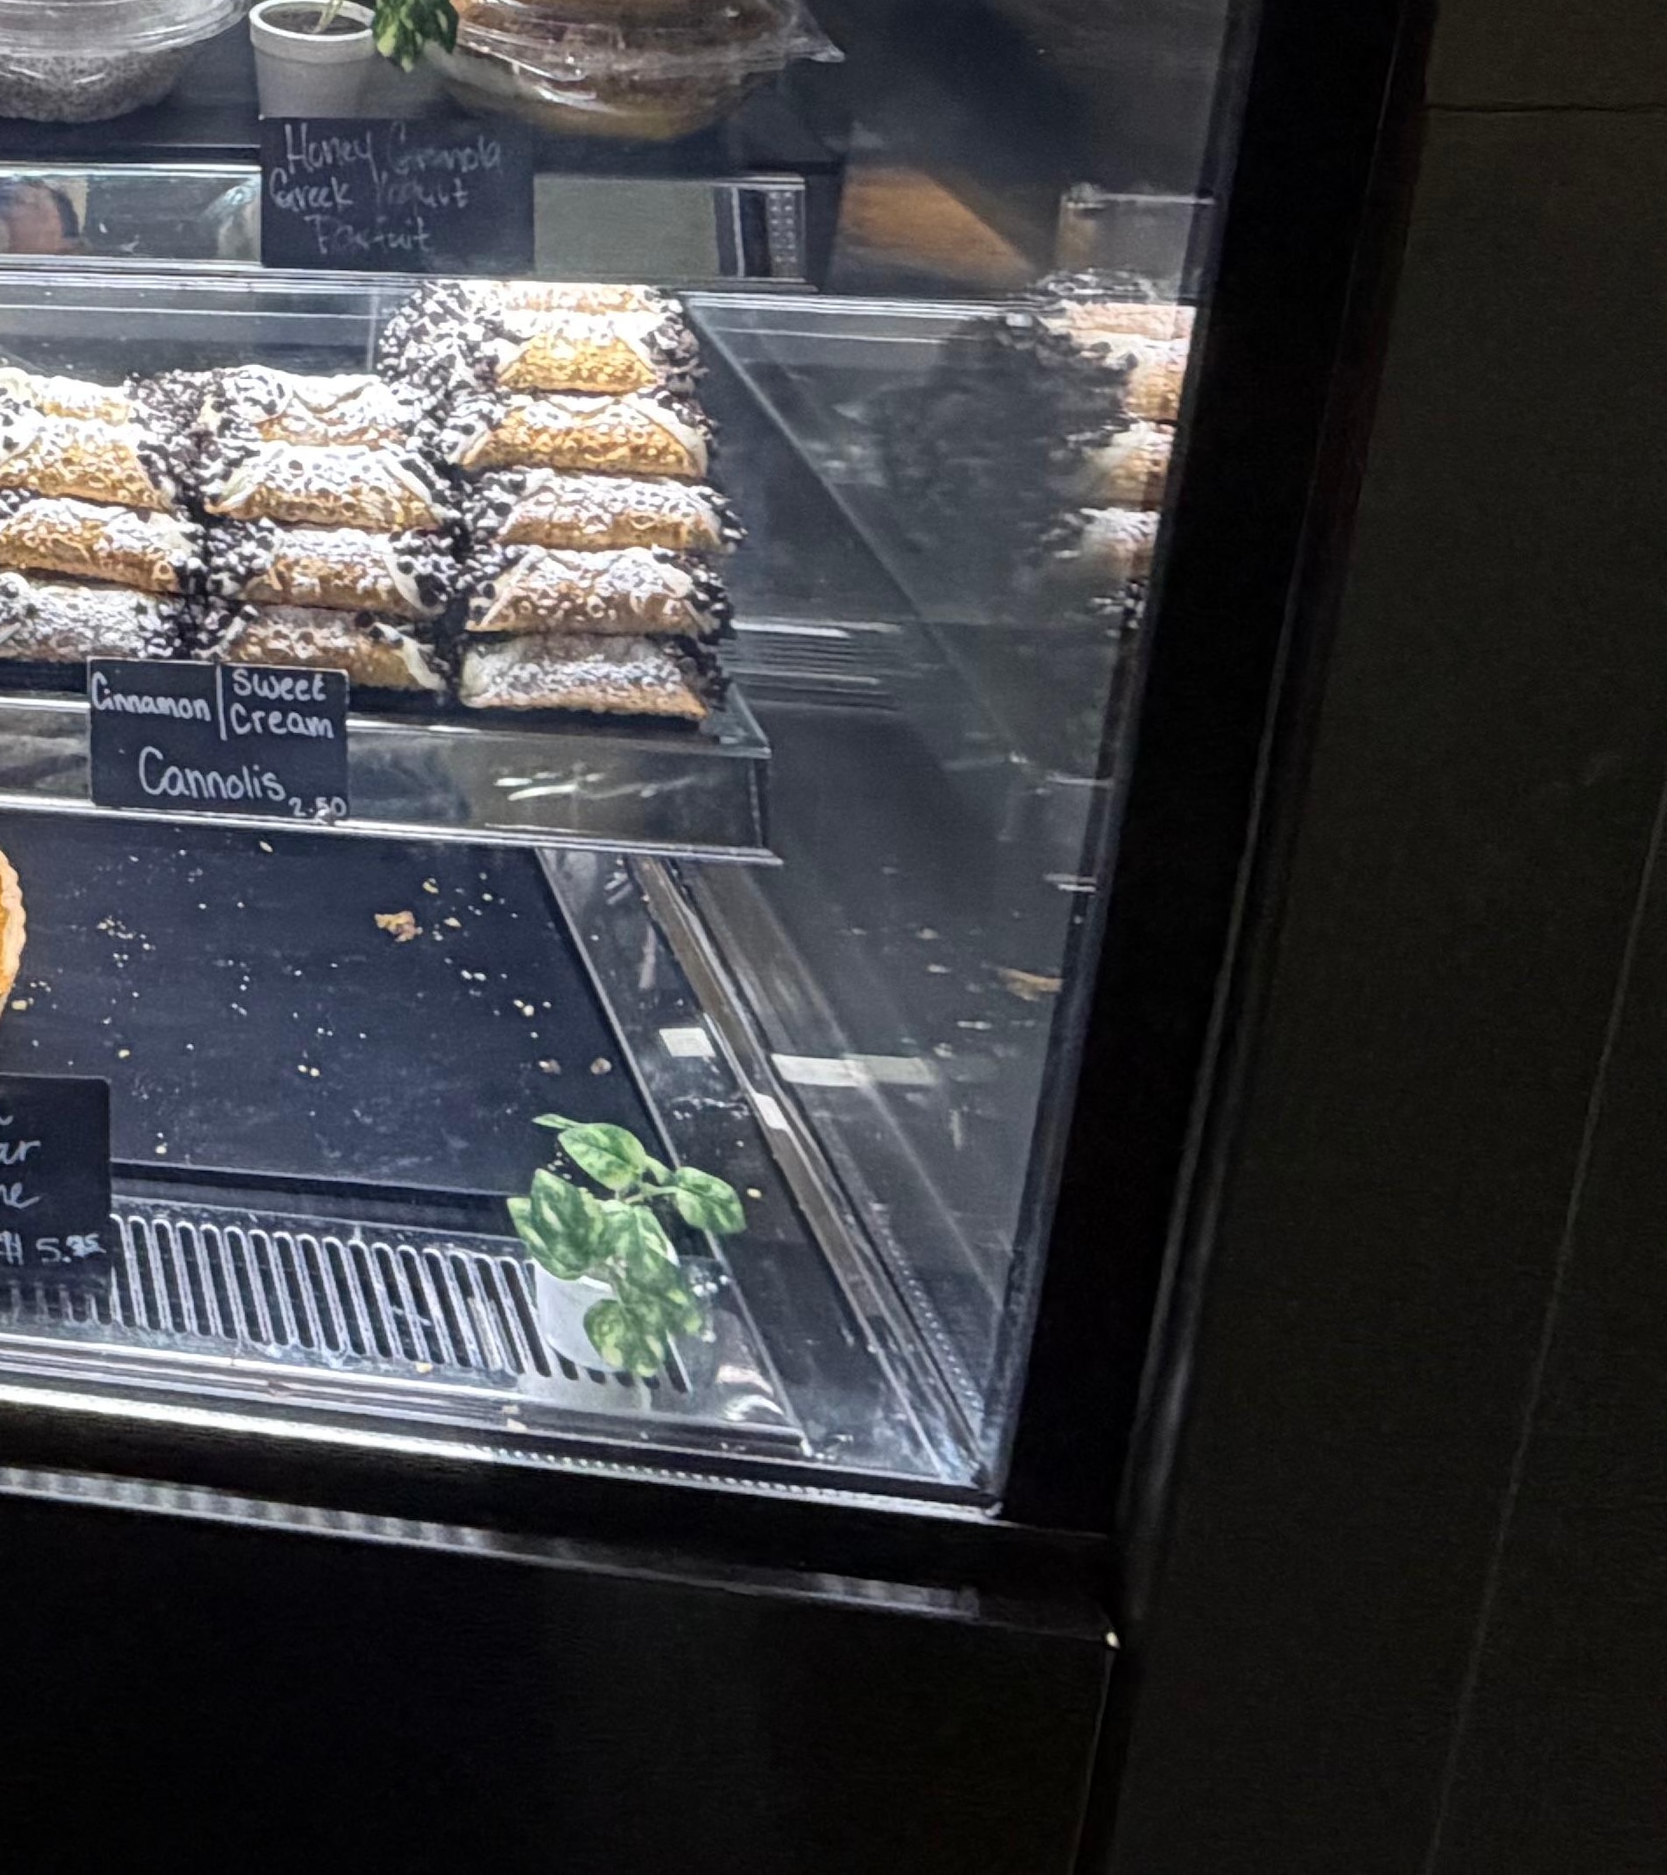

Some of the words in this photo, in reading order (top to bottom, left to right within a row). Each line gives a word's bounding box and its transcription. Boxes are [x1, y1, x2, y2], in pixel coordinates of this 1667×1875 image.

[284, 122, 379, 185] Honey
[269, 166, 355, 213] Greek
[91, 670, 212, 723] Cinnamon
[231, 667, 328, 702] Sweet
[229, 701, 336, 740] Cream
[138, 745, 287, 803] Cannolis
